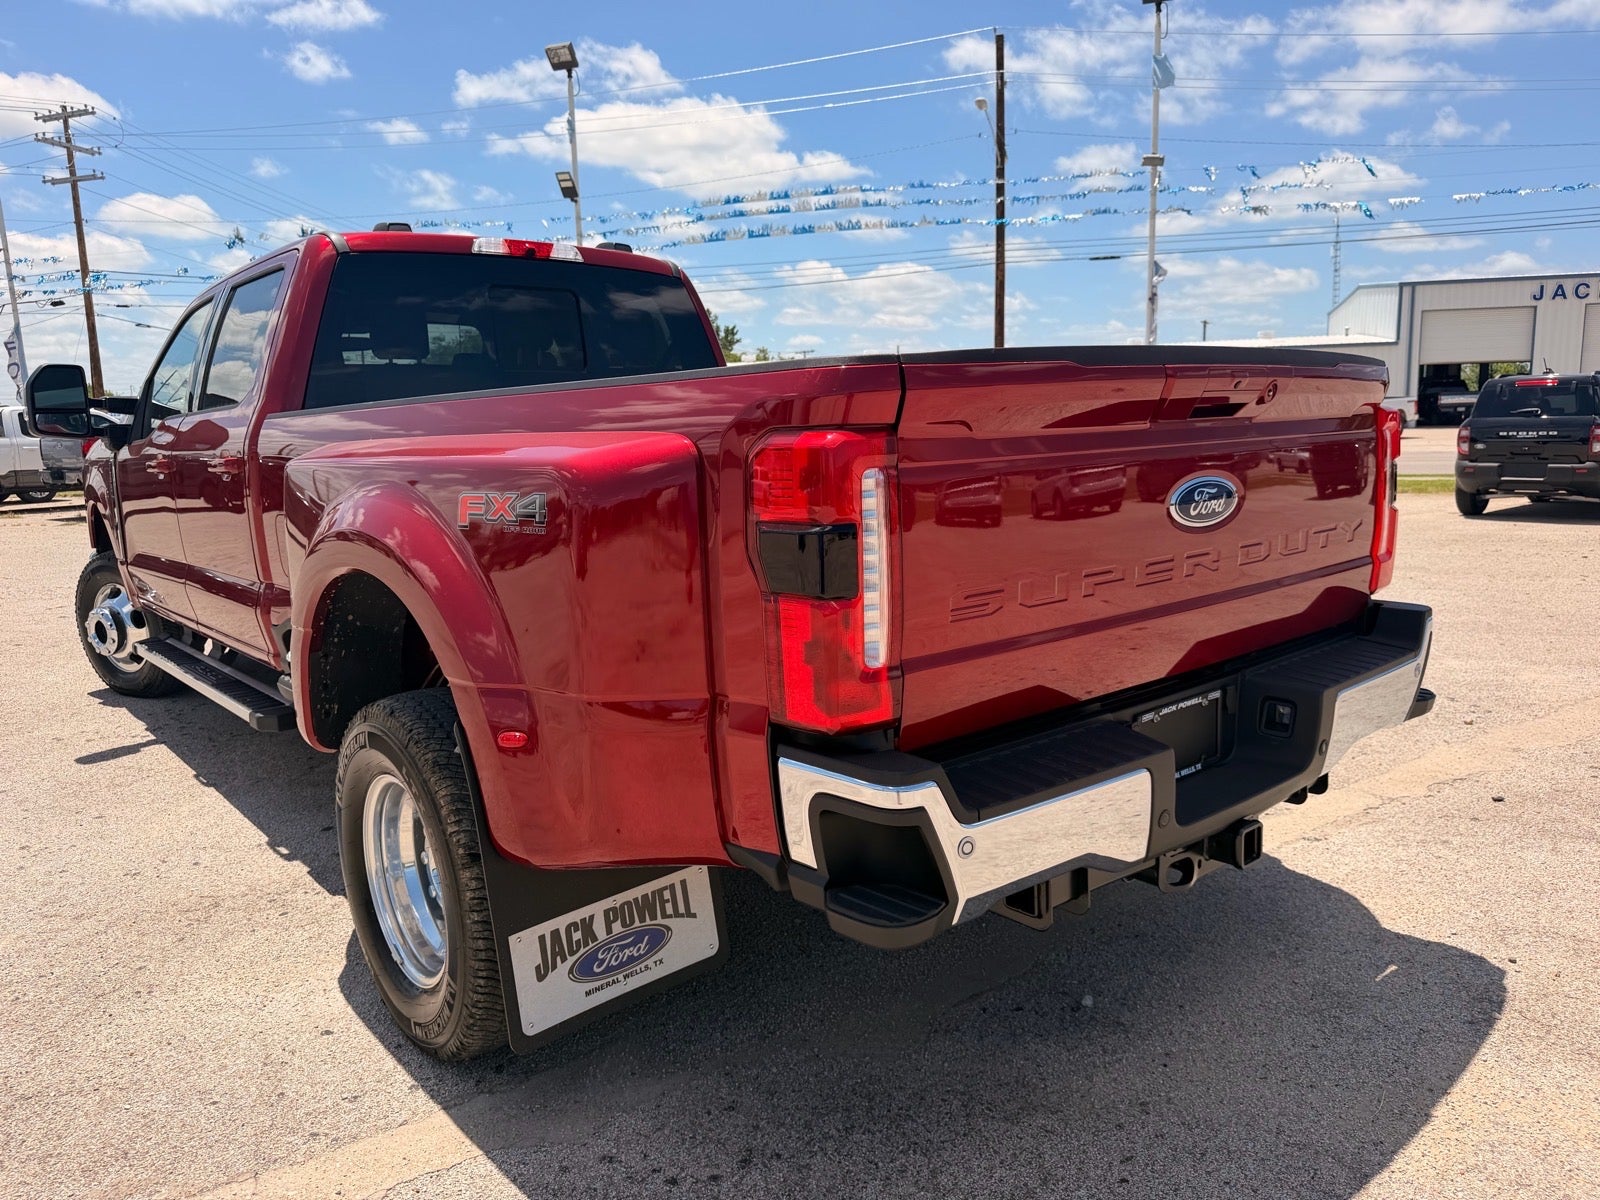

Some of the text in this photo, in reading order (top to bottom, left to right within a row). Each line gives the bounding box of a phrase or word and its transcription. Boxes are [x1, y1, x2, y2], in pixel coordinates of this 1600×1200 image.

[1533, 282, 1600, 300] JAC
[458, 491, 547, 529] FX4
[1190, 487, 1226, 516] Ford
[949, 518, 1364, 624] SUPER DUTY
[1159, 696, 1203, 716] JACK POWELL
[534, 878, 698, 983] JACK POWELL
[593, 935, 650, 973] Ford
[584, 957, 665, 998] MINERAL WELLS, TX
